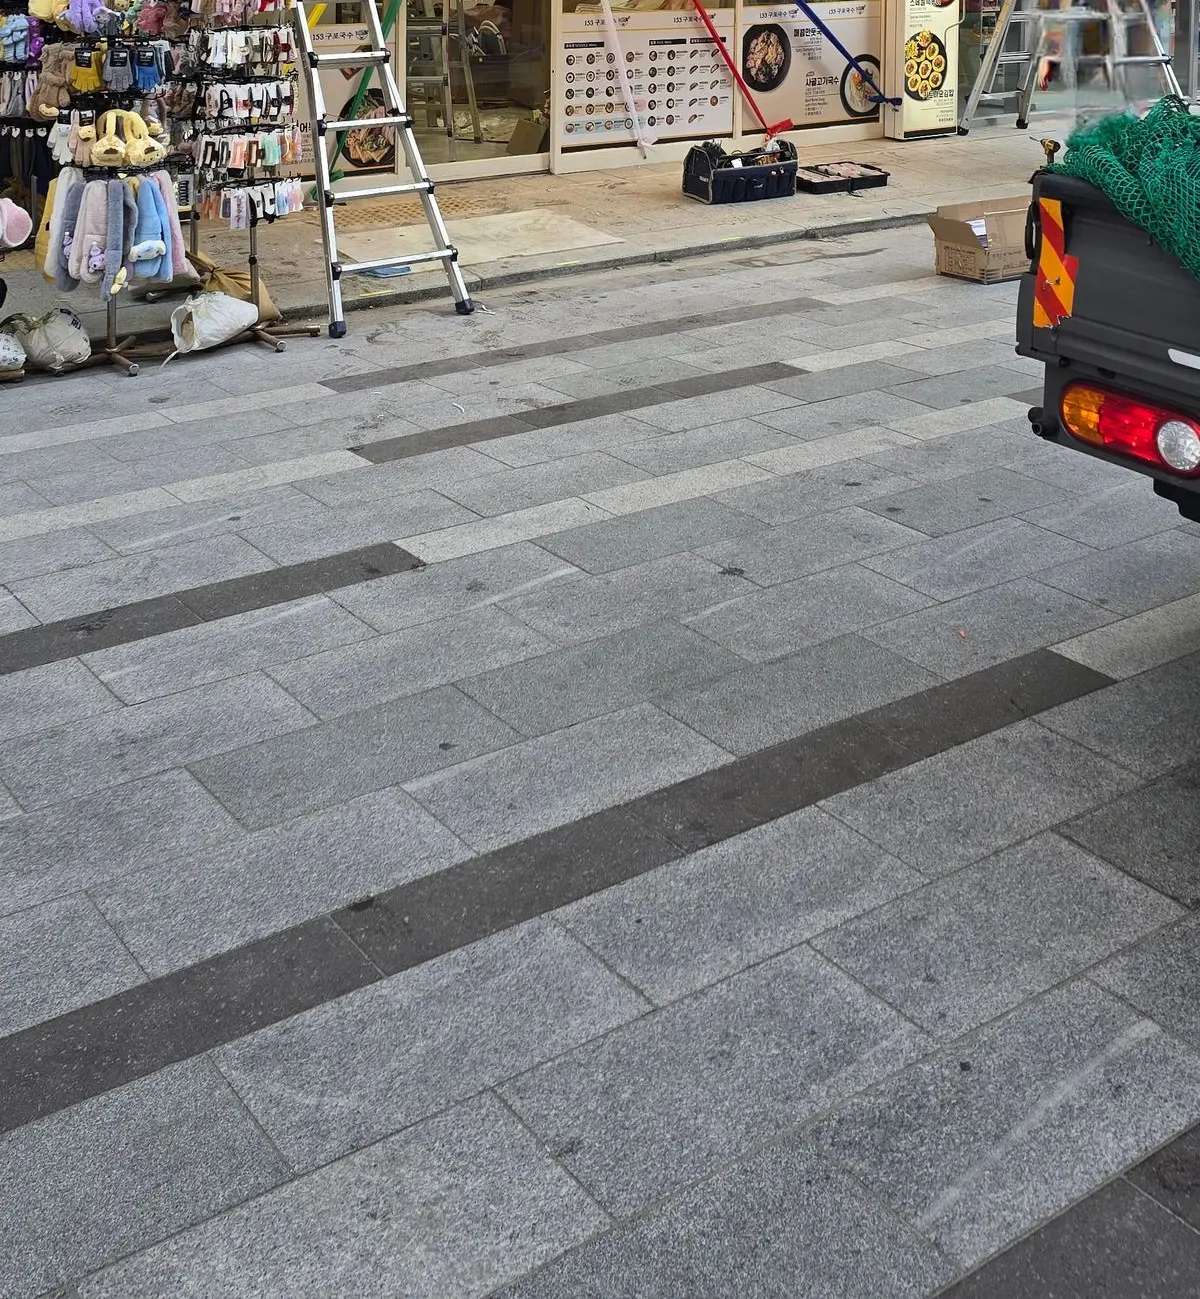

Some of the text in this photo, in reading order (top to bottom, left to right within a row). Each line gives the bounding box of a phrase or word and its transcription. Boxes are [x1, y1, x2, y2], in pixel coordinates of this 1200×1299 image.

[312, 31, 353, 41] 153 구포국수
[805, 75, 840, 87] 사골고기국수
